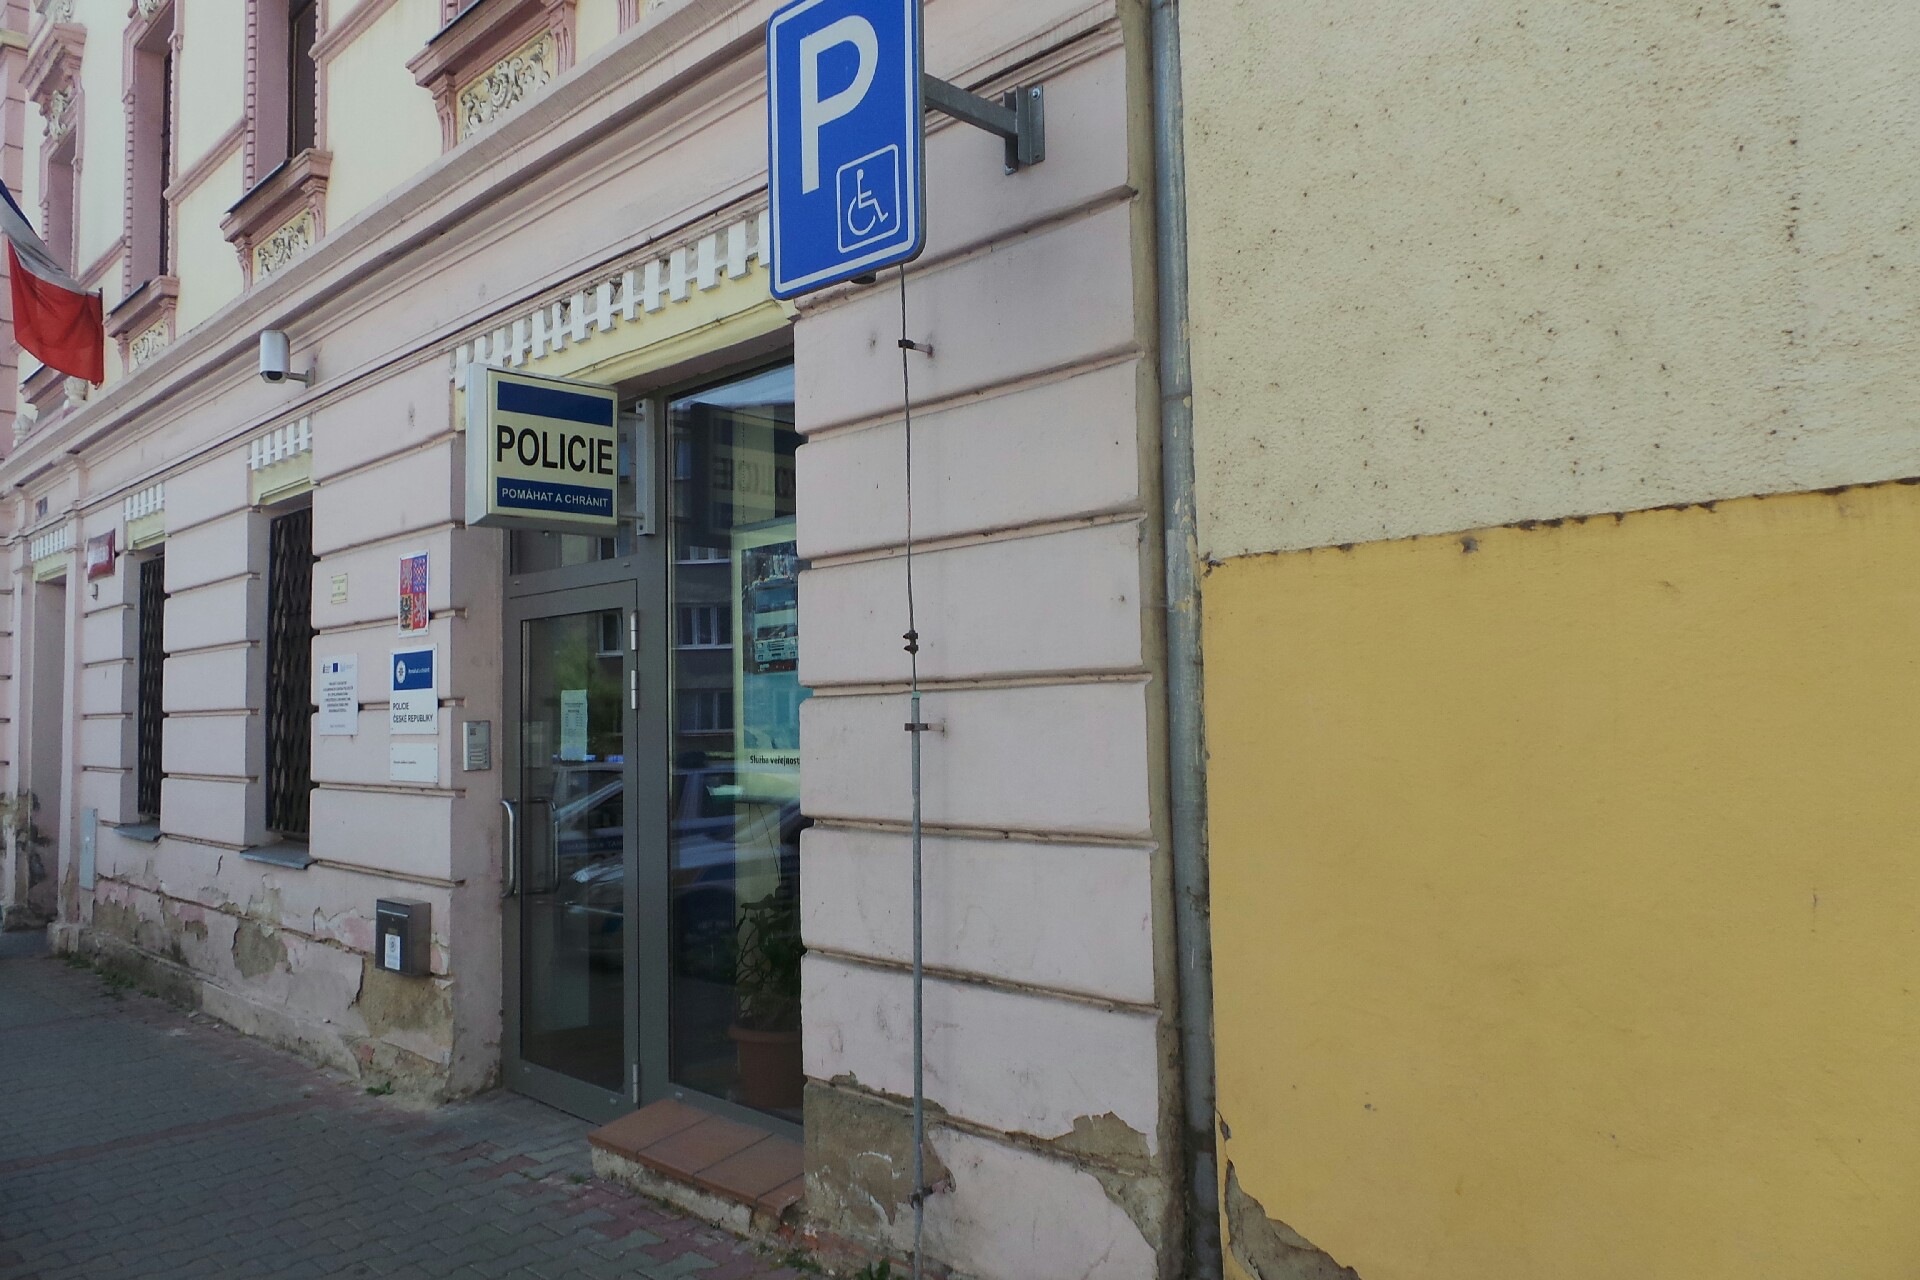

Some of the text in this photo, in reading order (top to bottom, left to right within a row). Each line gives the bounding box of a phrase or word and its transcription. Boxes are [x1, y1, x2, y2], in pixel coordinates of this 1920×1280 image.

[800, 15, 879, 195] P
[497, 425, 614, 475] POLICIE
[502, 488, 609, 508] POMÁHAT A CHRÁNIT
[392, 702, 409, 710] POLICIE
[770, 755, 800, 767] veřejnost
